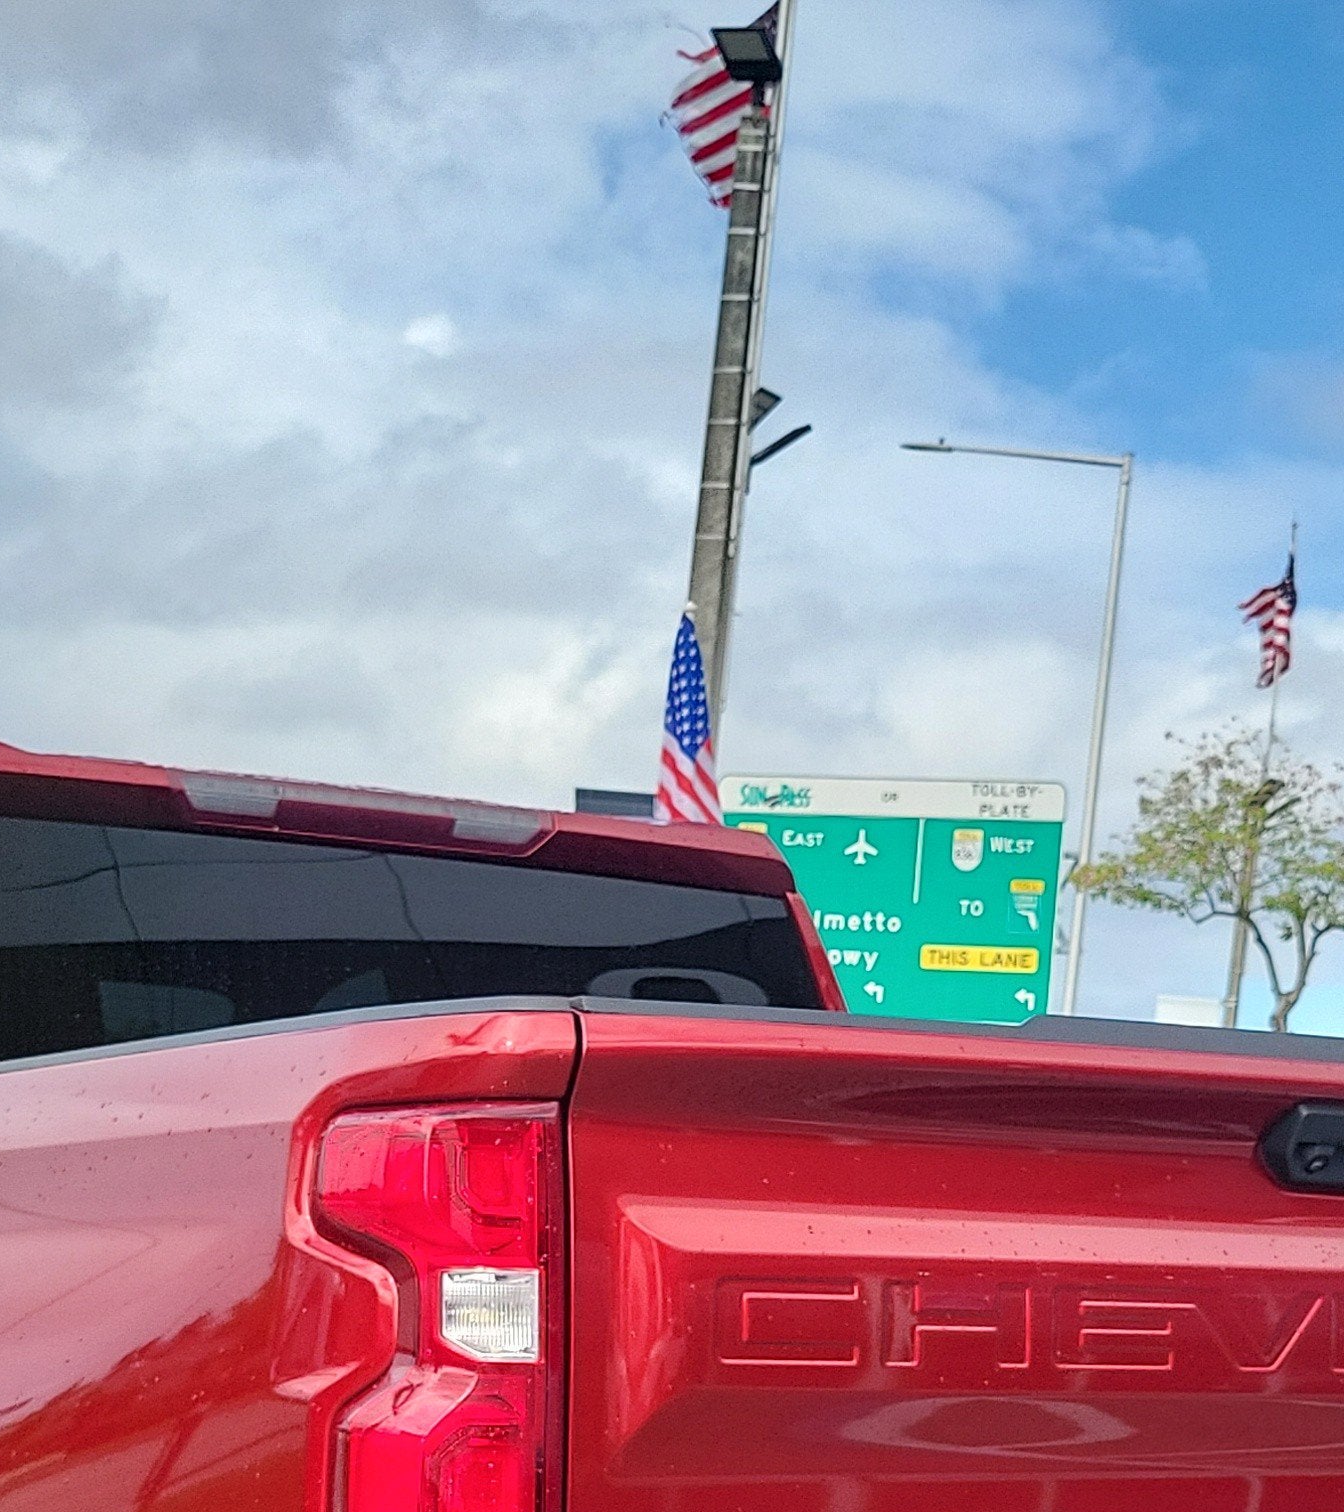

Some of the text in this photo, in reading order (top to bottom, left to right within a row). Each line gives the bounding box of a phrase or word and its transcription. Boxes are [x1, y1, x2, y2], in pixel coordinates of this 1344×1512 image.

[978, 803, 1032, 819] PLATE
[782, 829, 825, 848] EAST
[989, 836, 1035, 854] WEST
[959, 899, 984, 917] TO
[812, 909, 902, 933] lmetto
[929, 949, 1032, 969] THIS LANE
